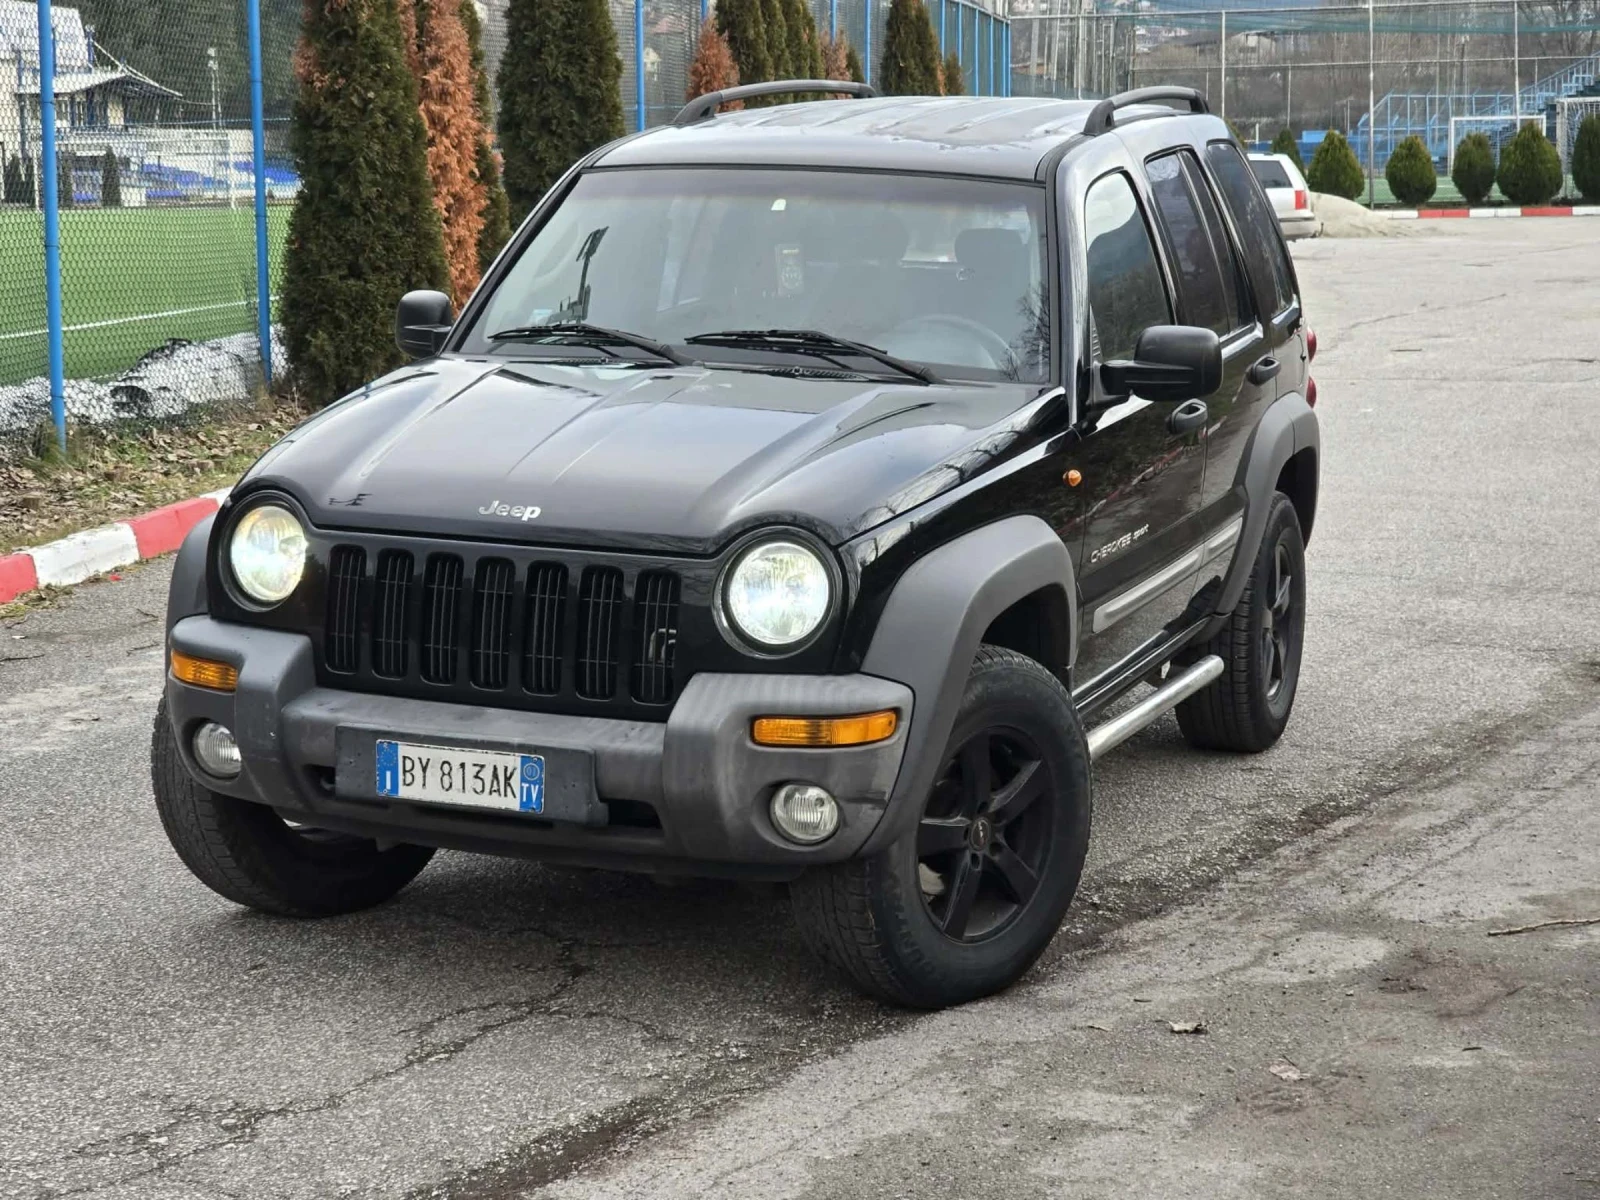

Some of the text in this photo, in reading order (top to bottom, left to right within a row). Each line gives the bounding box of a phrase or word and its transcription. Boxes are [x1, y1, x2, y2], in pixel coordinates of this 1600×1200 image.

[478, 500, 542, 521] Jeep
[402, 755, 517, 798] BY 813AK
[521, 782, 539, 804] TV
